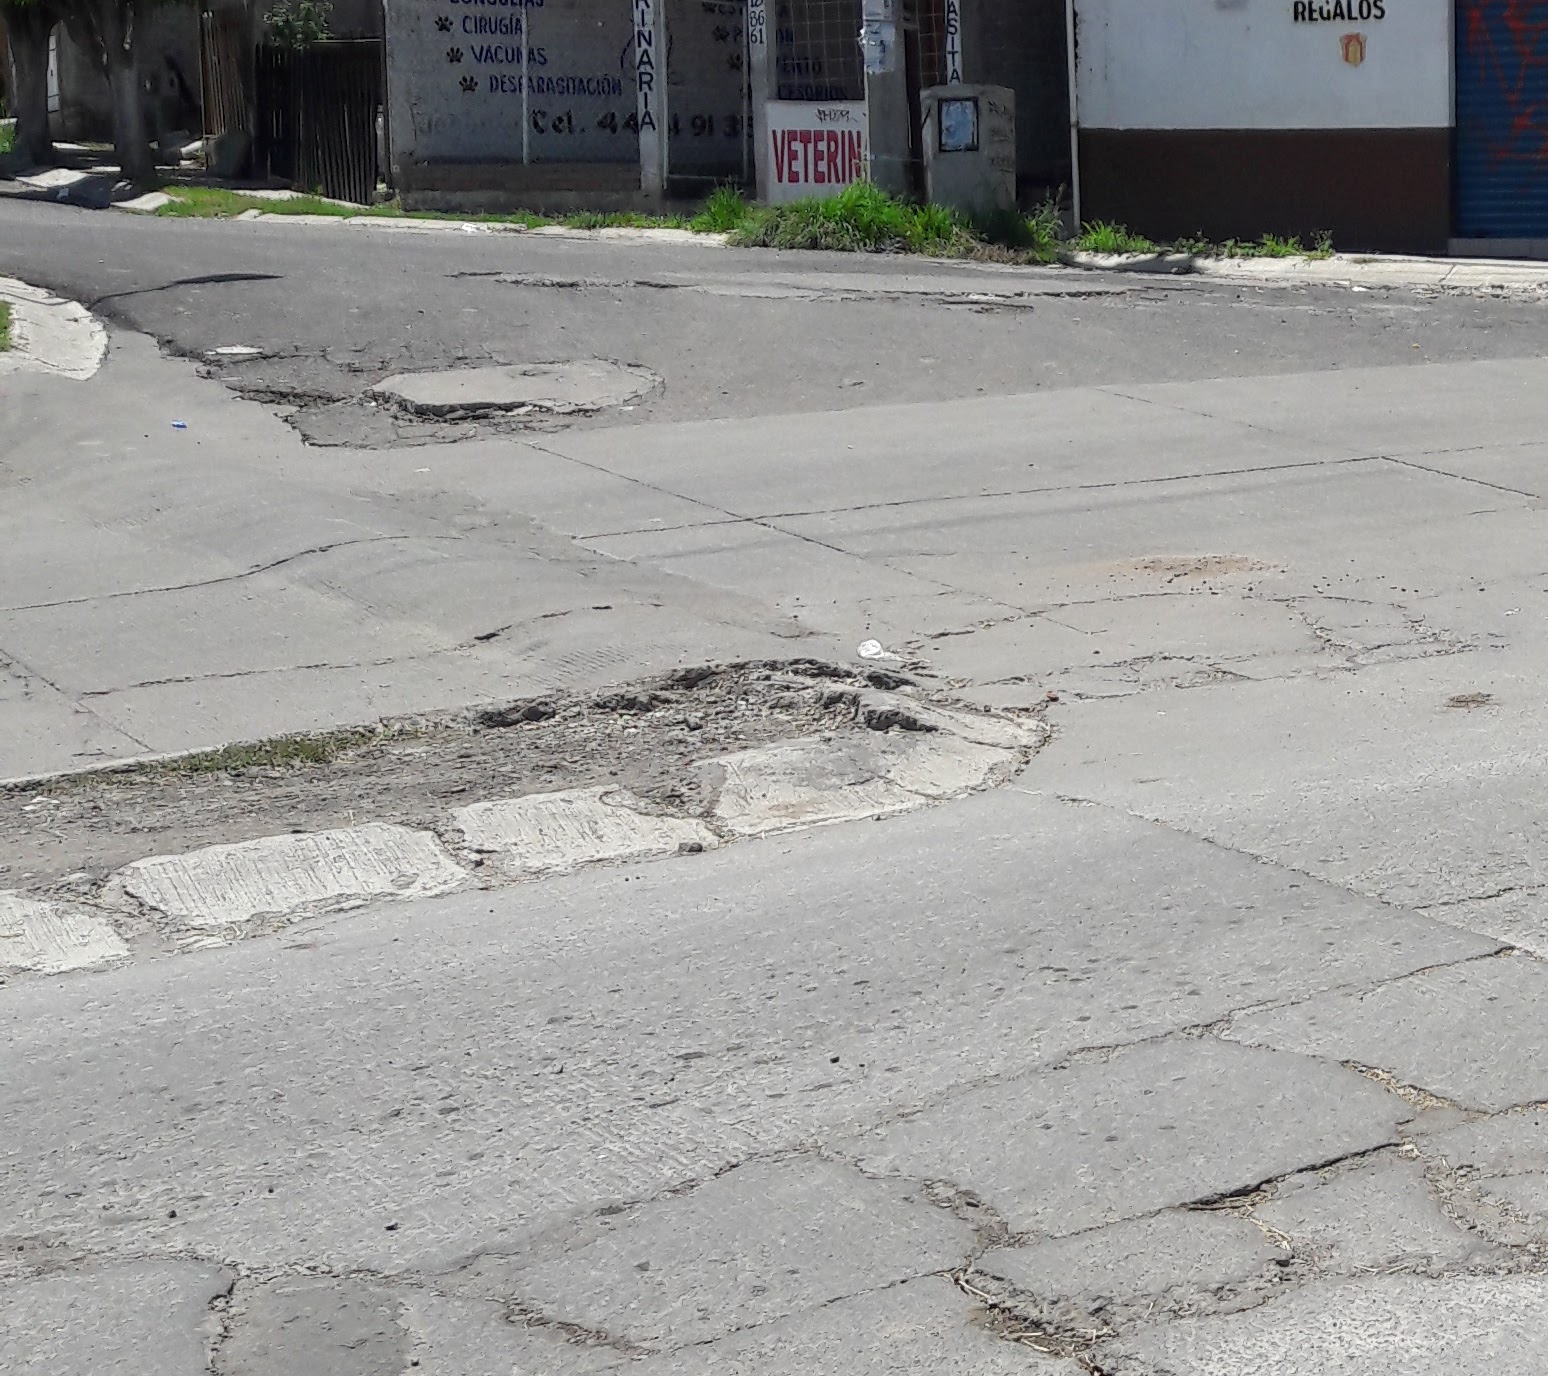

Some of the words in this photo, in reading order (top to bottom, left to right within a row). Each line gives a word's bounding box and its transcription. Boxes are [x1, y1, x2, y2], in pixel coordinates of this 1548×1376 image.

[749, 29, 765, 44] 61
[470, 44, 548, 66] VACUNAS
[772, 129, 862, 184] VETERIN
